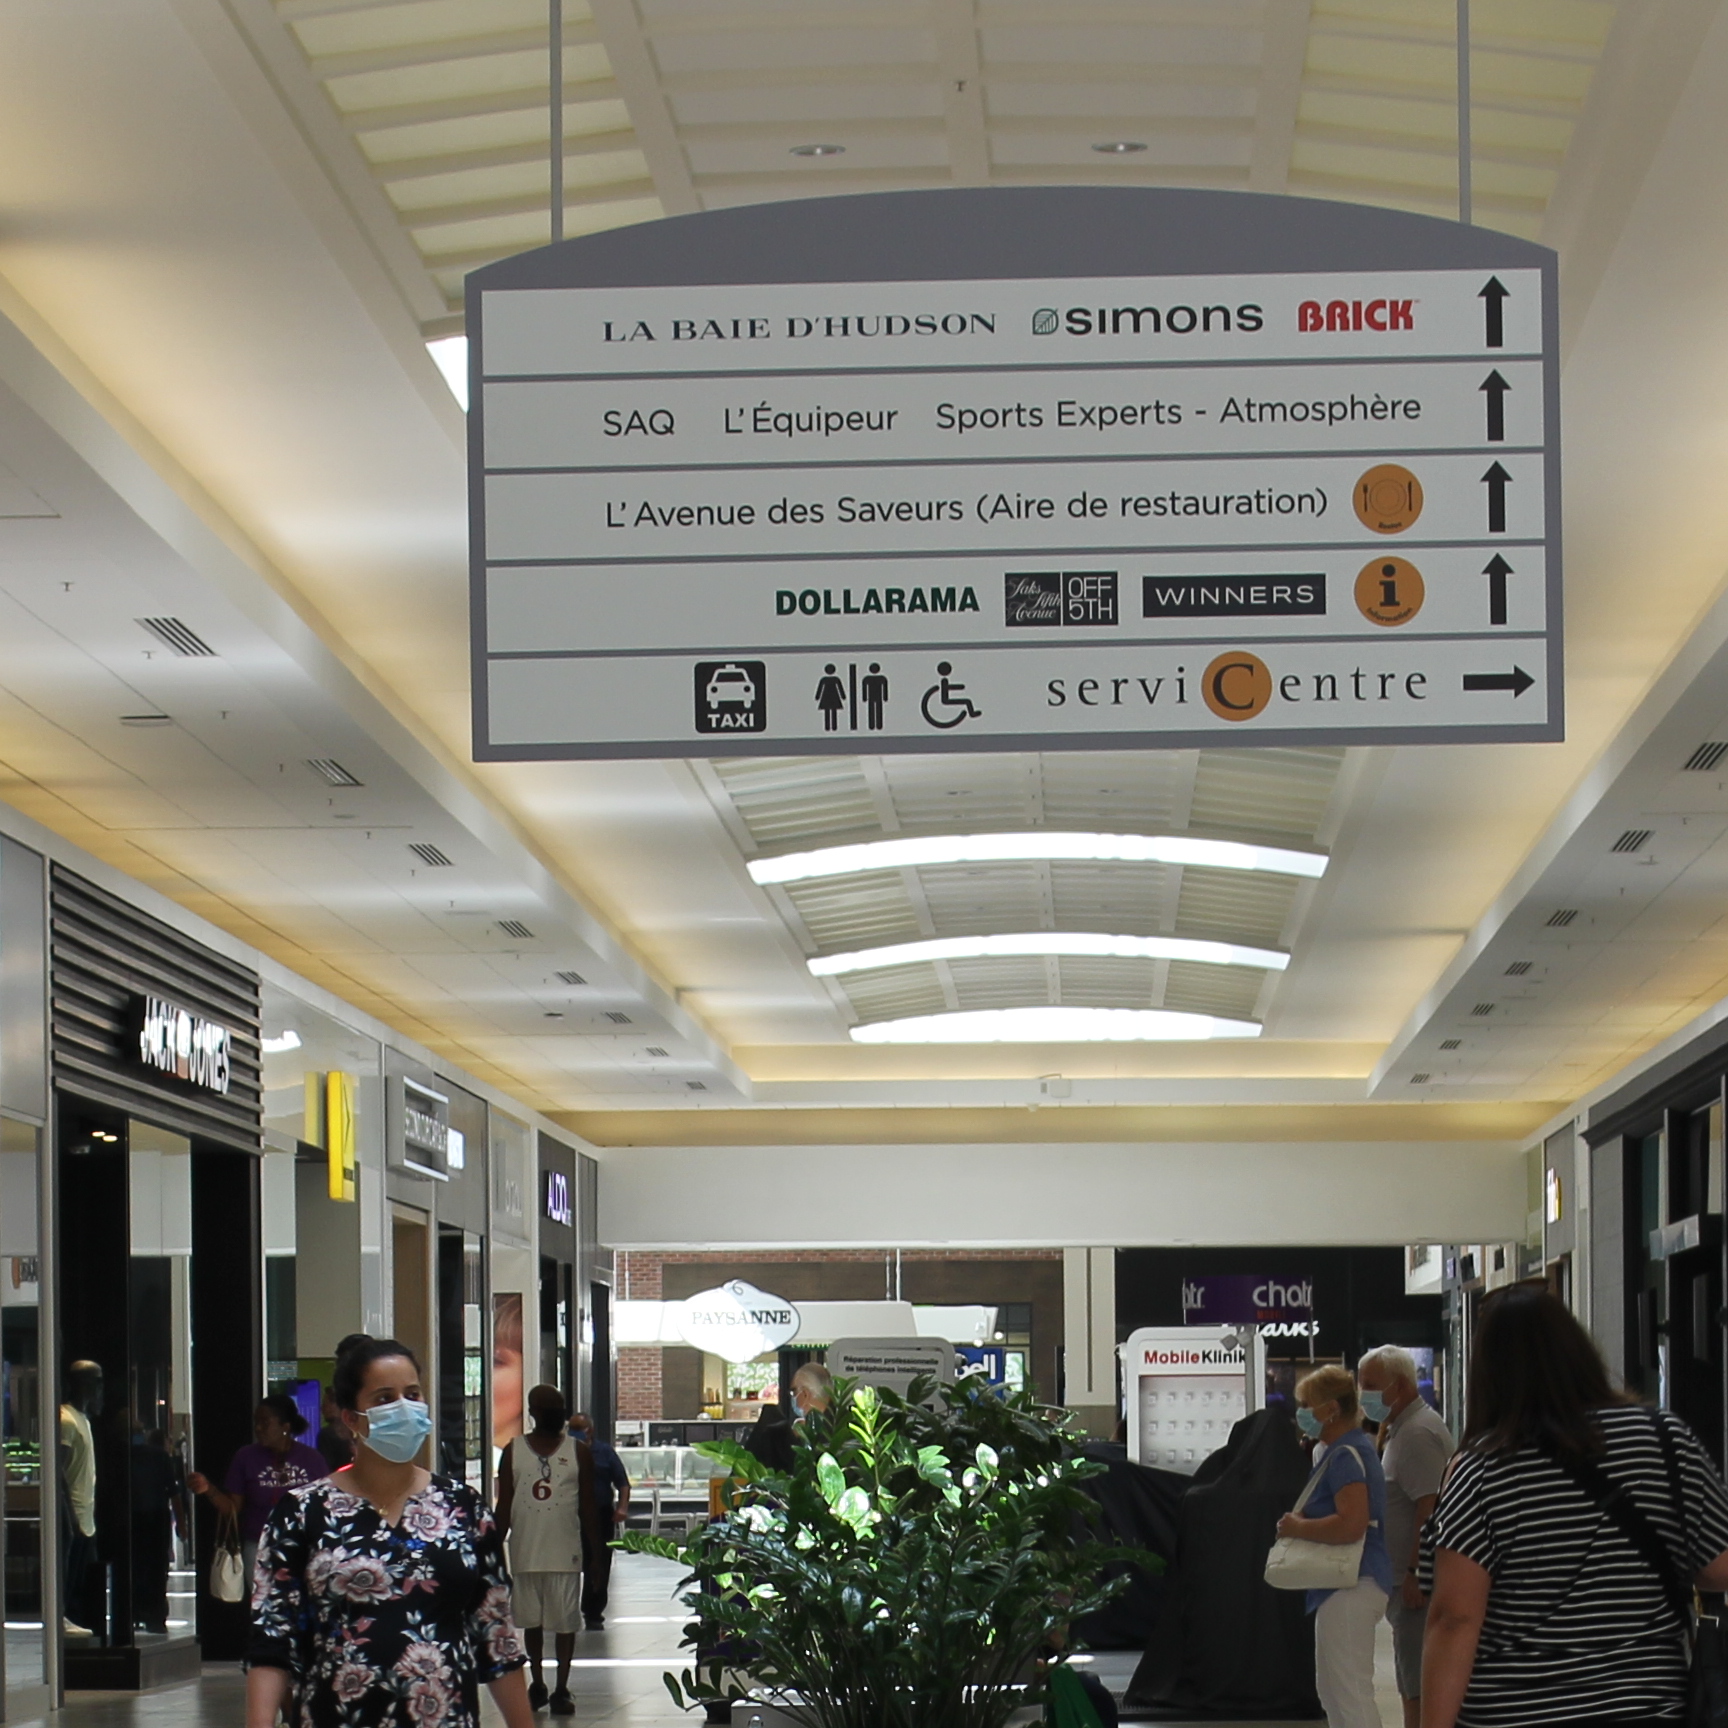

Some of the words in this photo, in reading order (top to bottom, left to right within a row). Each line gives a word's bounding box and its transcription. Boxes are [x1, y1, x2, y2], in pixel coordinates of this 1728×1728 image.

[603, 320, 657, 343] LA
[672, 317, 771, 341] BAIE
[786, 313, 997, 339] D'HUDSON
[1065, 304, 1264, 336] simons
[1298, 299, 1414, 332] BRICK
[603, 409, 675, 436] SAQ
[936, 402, 1044, 433] Sports
[1057, 399, 1183, 431] Experts
[1220, 393, 1422, 427] Atmosphère
[768, 497, 825, 524] des
[837, 496, 964, 524] Saveurs
[975, 493, 1056, 524] (Aire
[1067, 491, 1109, 519] de
[1120, 487, 1329, 517] restauration)
[775, 587, 980, 616] DOLLARAMA
[1068, 576, 1112, 599] OFF
[1155, 585, 1315, 606] WINNERS
[1069, 598, 1113, 620] 5TH
[707, 713, 755, 729] TAXI
[532, 1478, 552, 1500] 6
